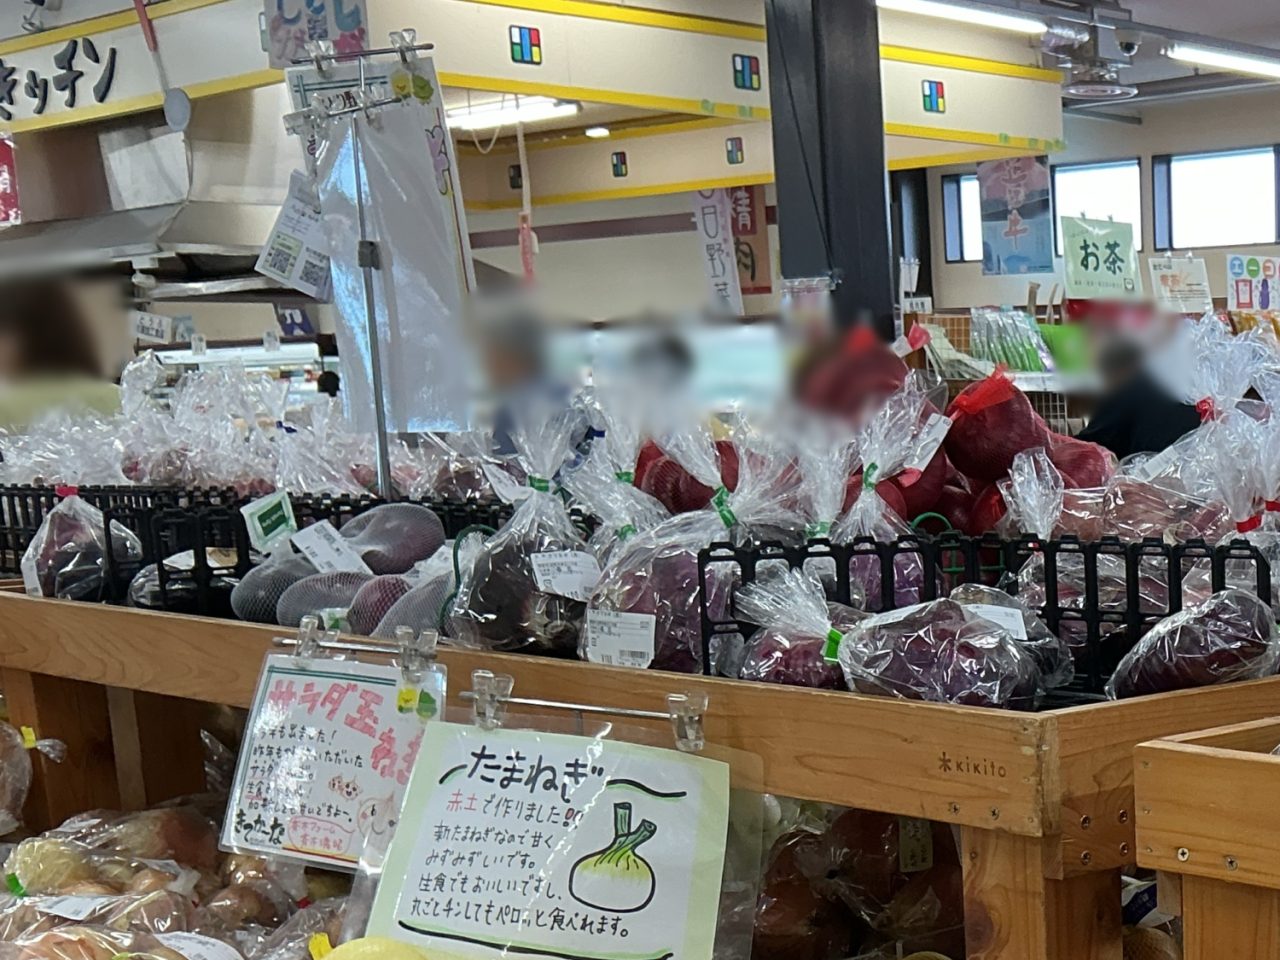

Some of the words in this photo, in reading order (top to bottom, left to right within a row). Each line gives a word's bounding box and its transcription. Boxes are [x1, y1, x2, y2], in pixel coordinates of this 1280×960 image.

[1080, 239, 1125, 276] お茶
[468, 745, 604, 803] たまねぎ
